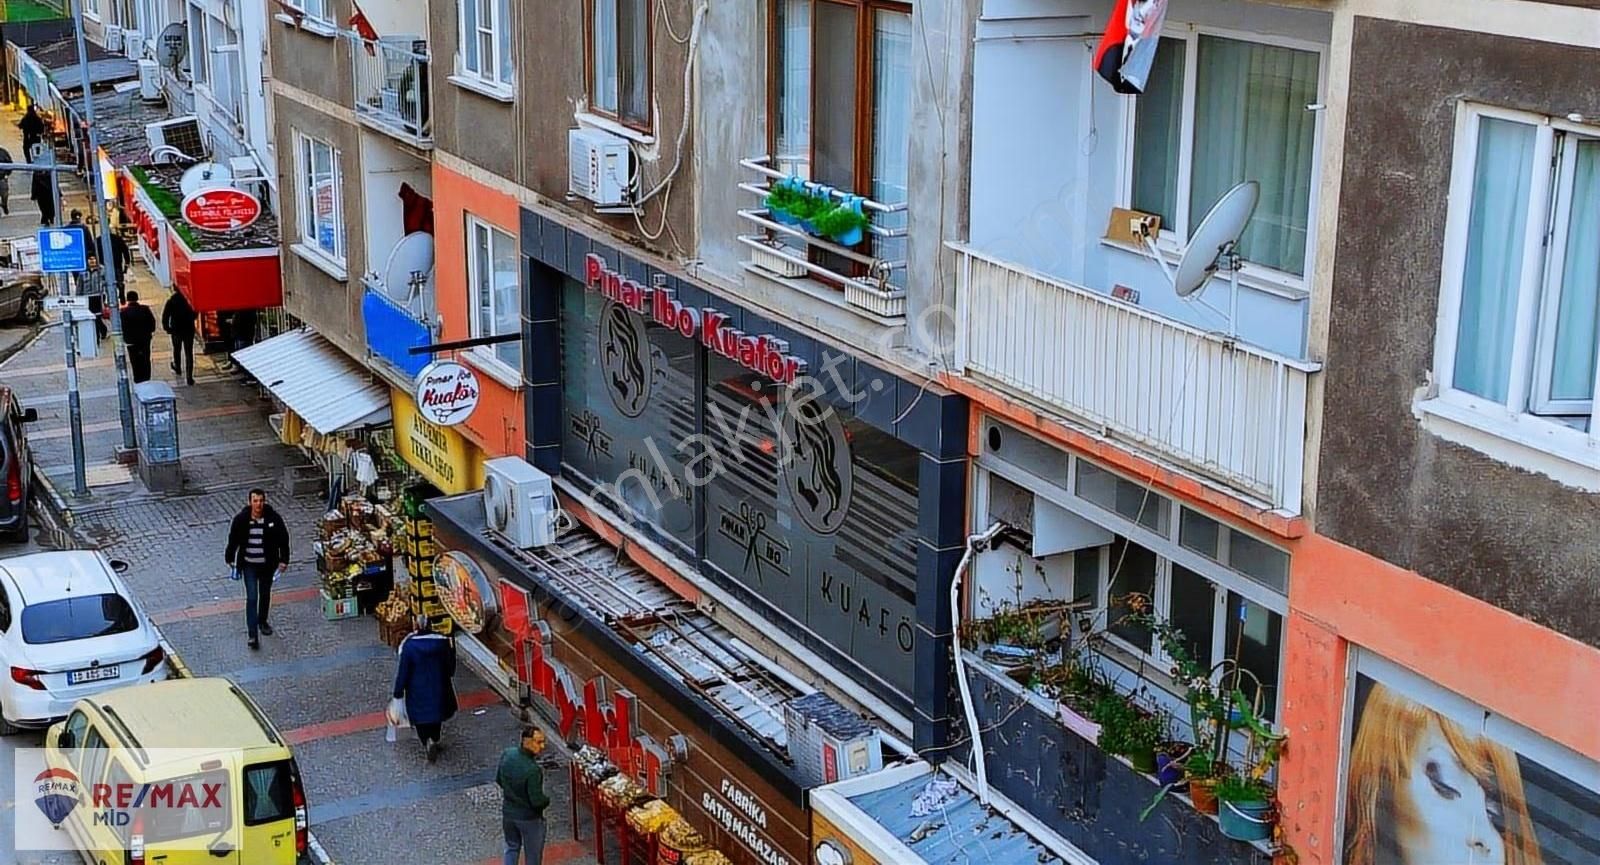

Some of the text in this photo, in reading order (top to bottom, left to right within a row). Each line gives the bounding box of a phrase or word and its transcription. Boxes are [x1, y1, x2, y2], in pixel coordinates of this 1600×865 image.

[585, 252, 808, 388] Pınar İbo Kuaför
[421, 381, 478, 408] Kuaför
[702, 792, 734, 833] SATIŞ
[721, 779, 768, 829] FABRİKA
